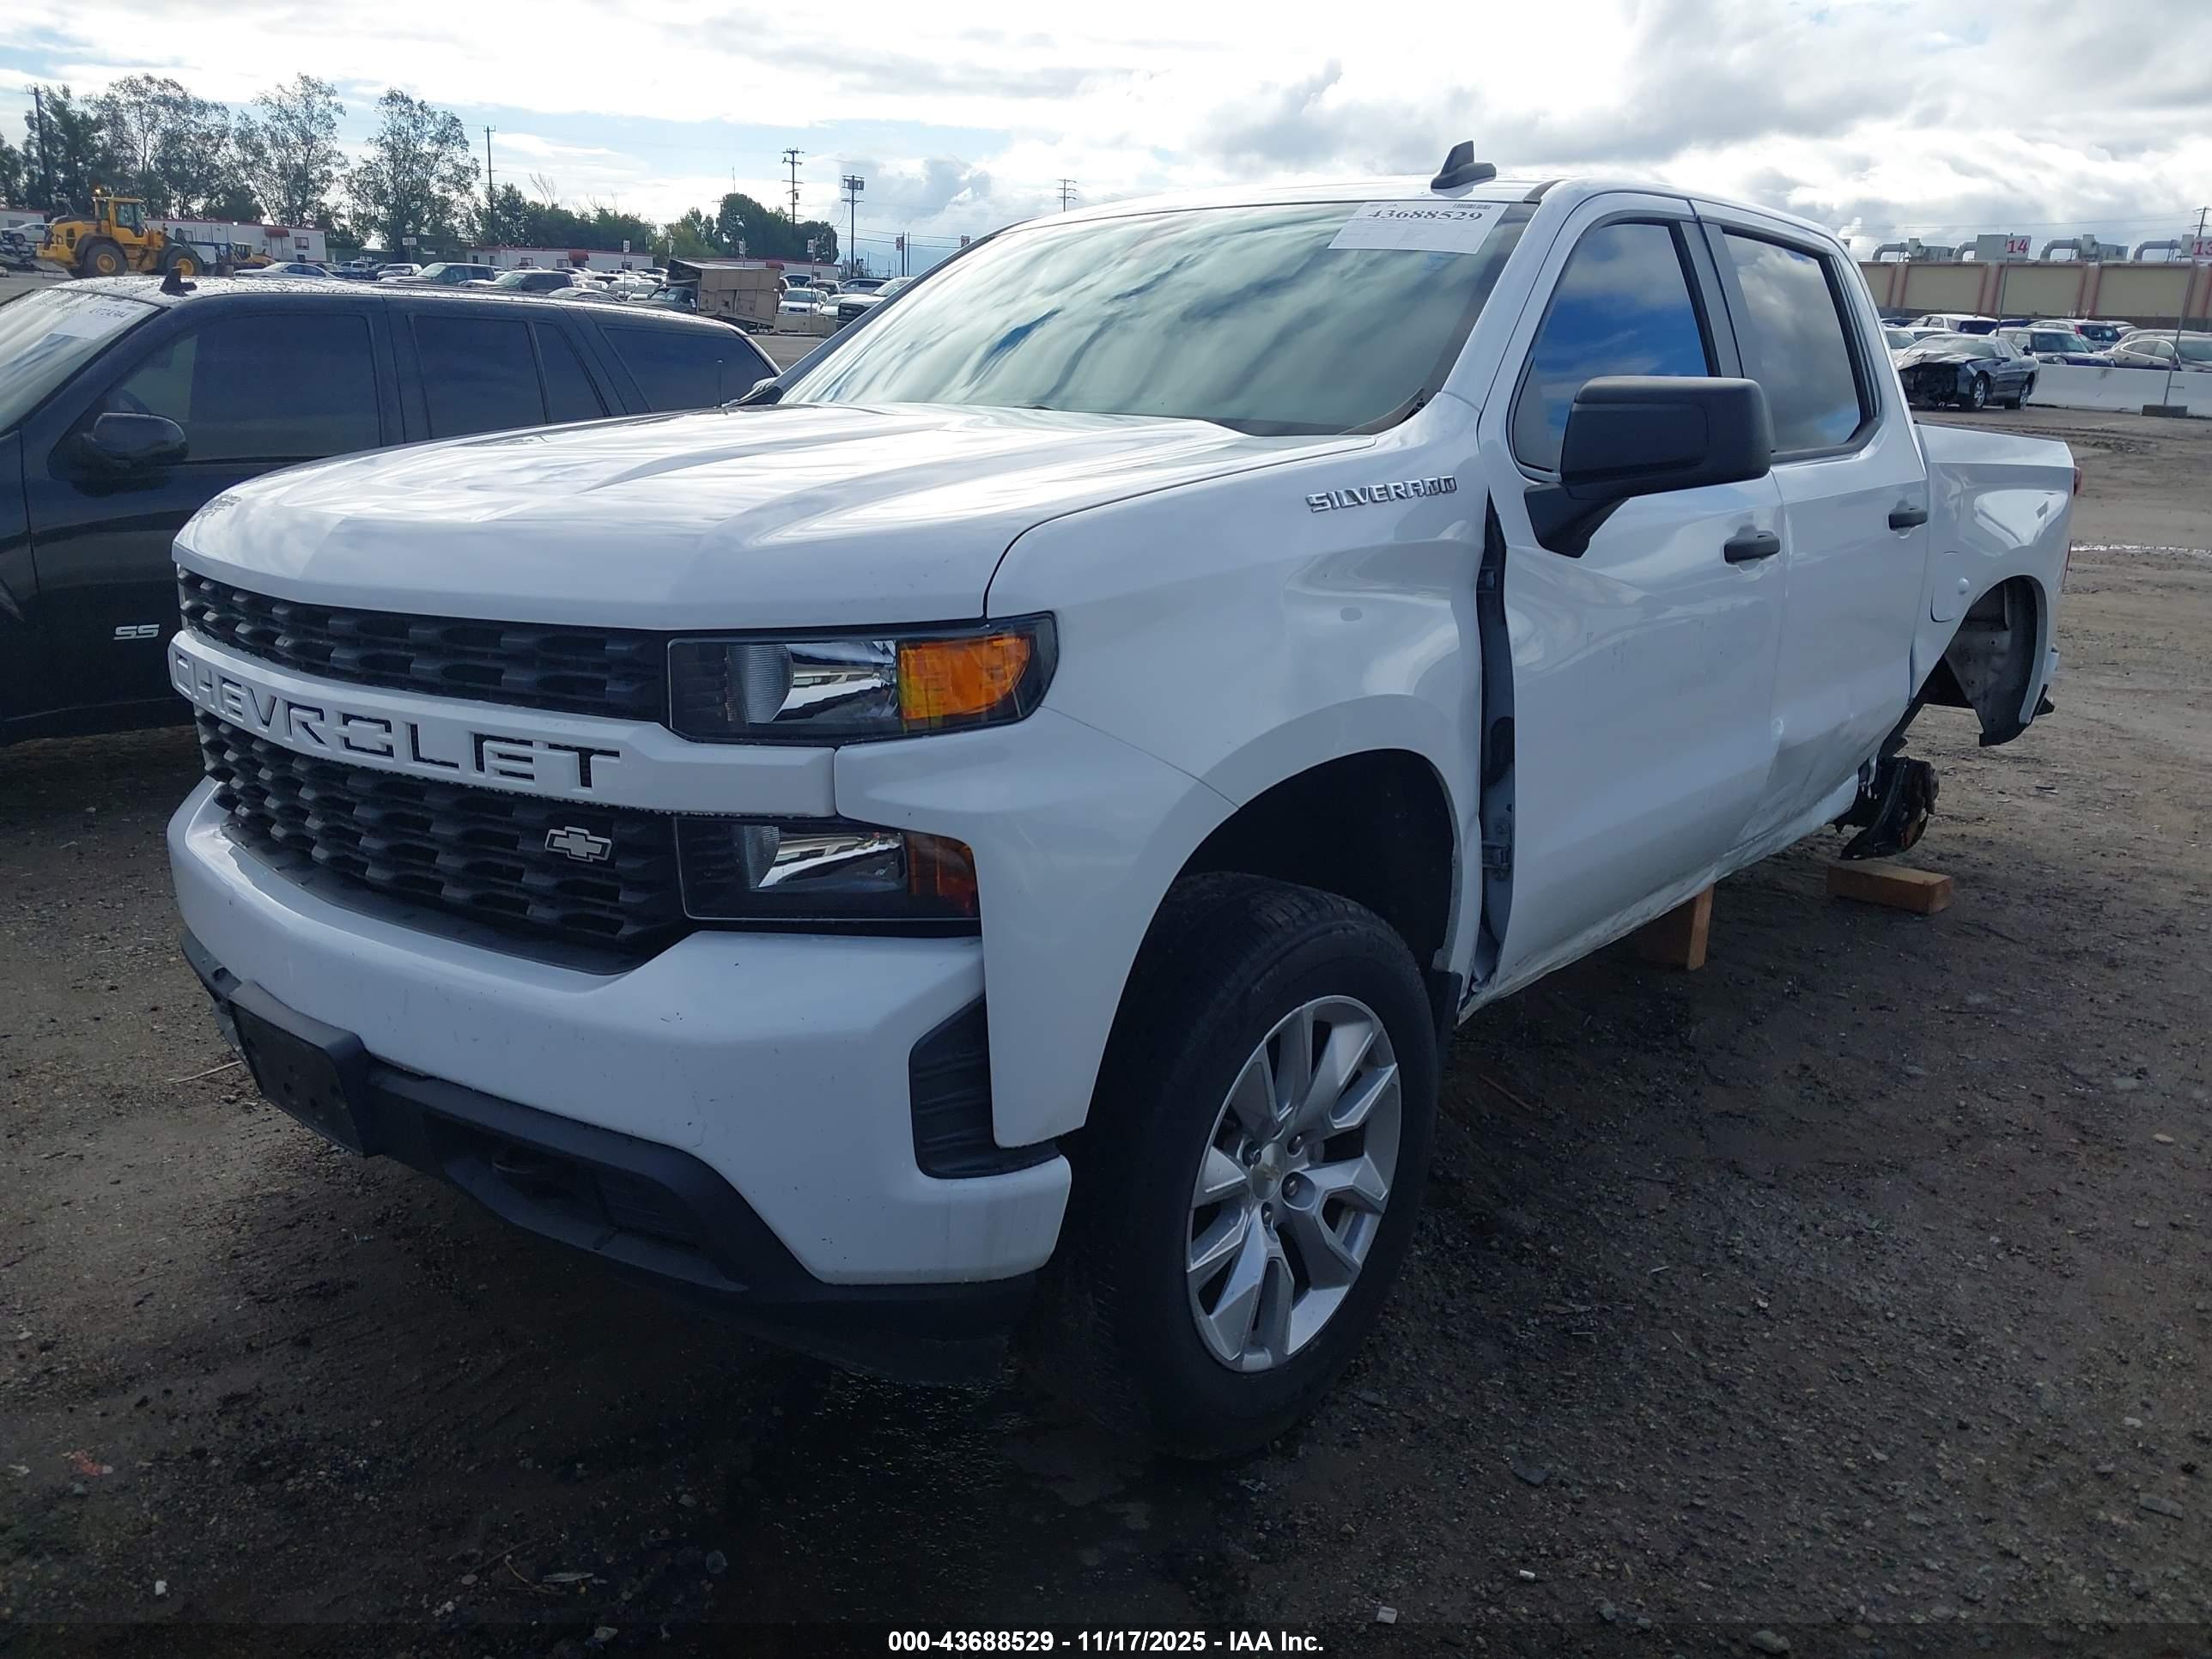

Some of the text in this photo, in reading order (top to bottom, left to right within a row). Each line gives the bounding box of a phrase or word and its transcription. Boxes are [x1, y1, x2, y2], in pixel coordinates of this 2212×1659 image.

[1366, 209, 1483, 222] 43688529
[2007, 239, 2028, 254] 14
[1305, 475, 1458, 514] SILVERADO
[113, 623, 160, 641] SS
[173, 649, 622, 792] CHEVROLET
